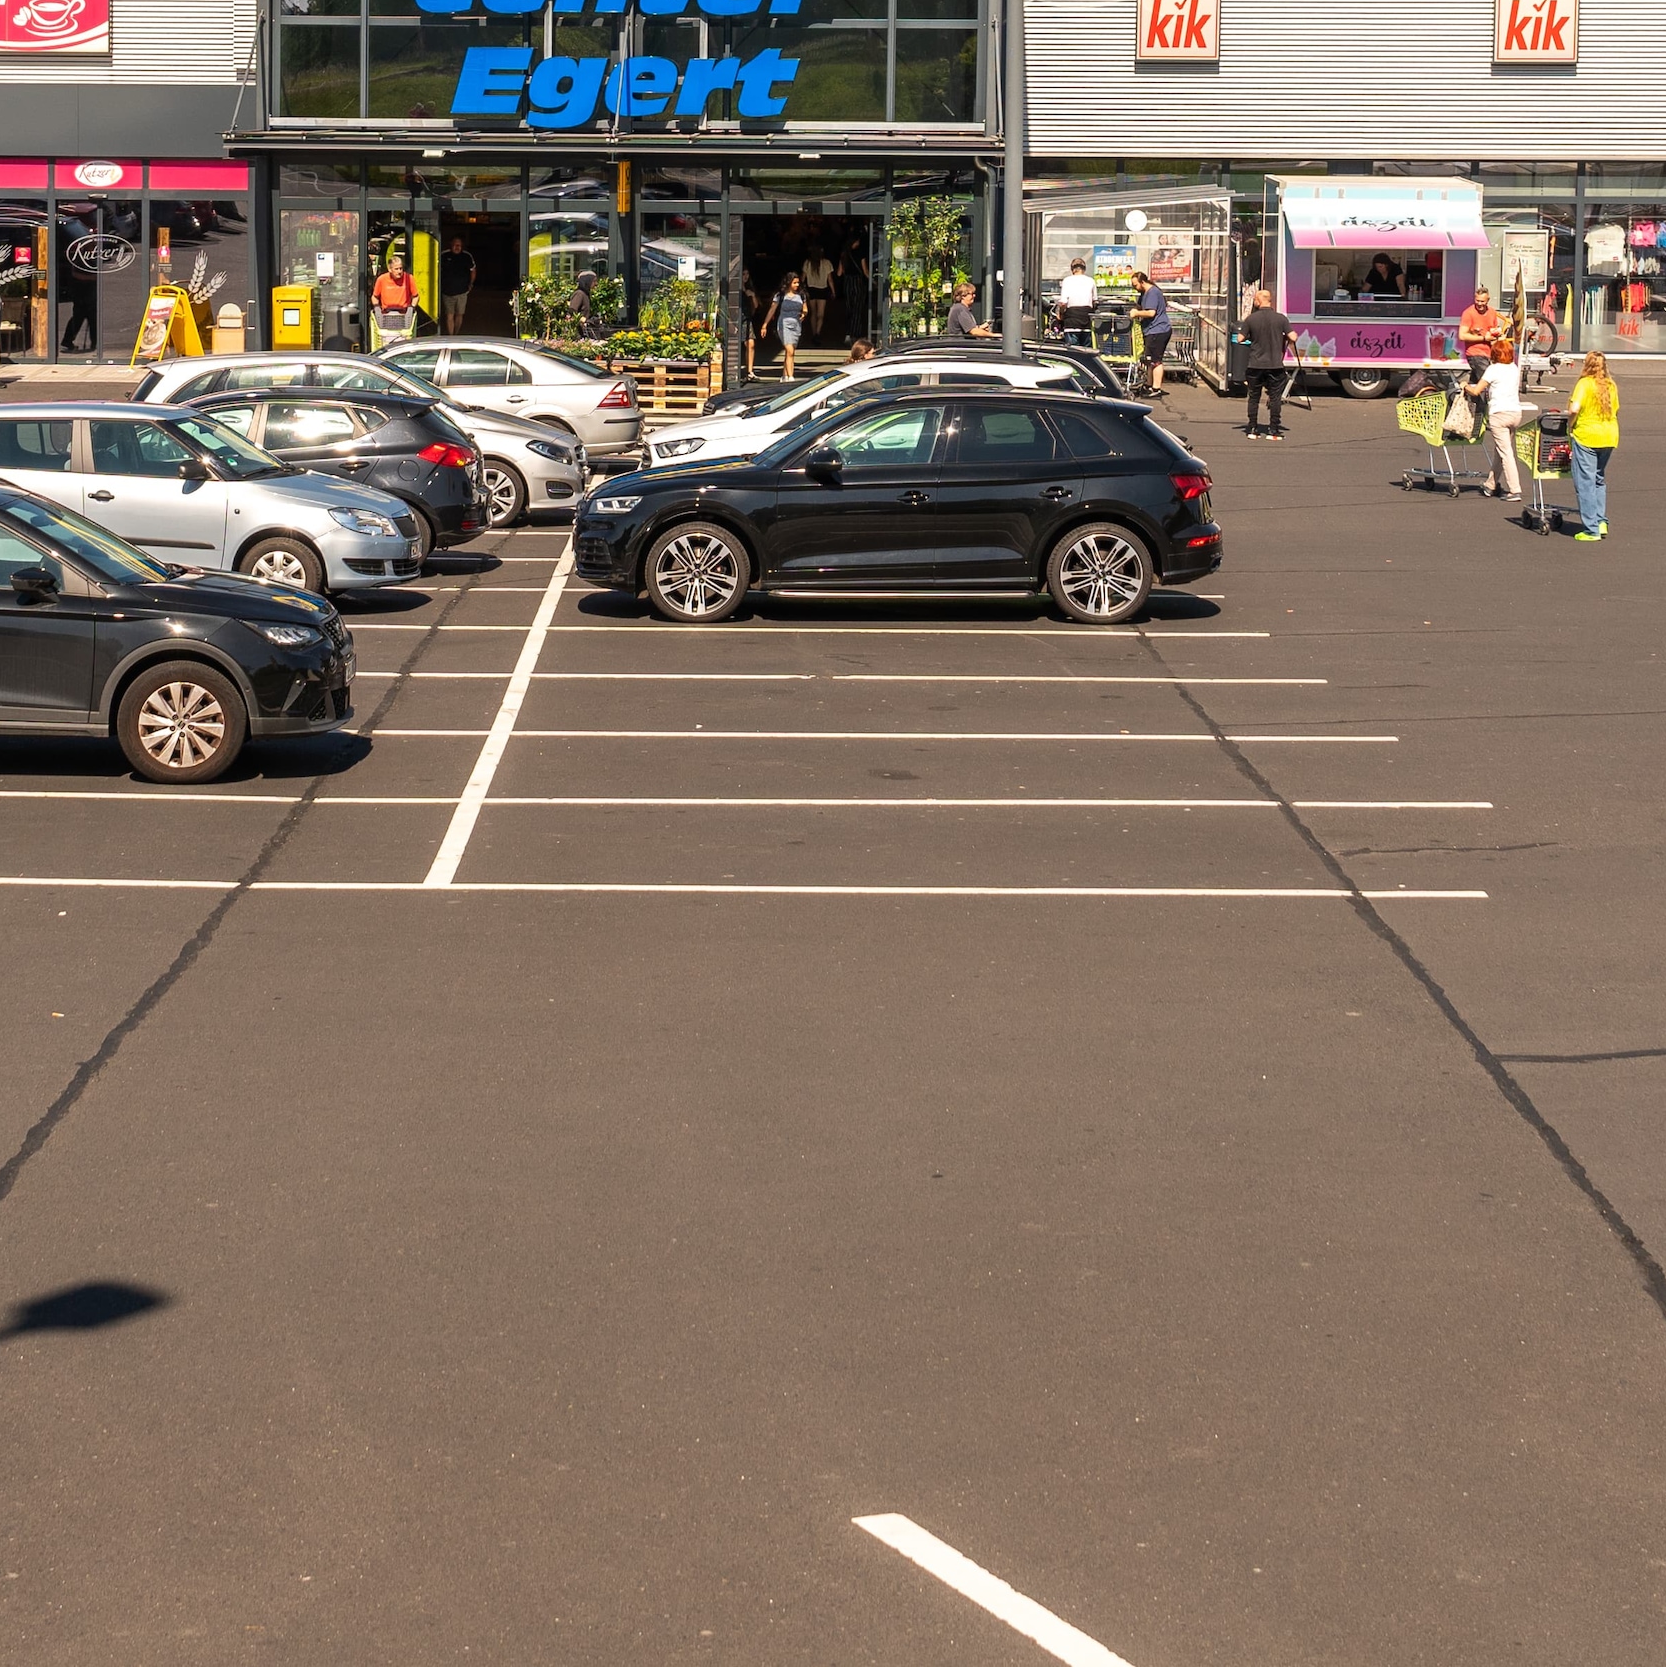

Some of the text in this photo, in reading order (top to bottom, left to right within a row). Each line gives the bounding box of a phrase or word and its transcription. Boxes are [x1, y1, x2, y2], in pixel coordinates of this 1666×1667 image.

[450, 47, 801, 129] Egert
[79, 163, 112, 185] Kutzer
[71, 238, 120, 270] Kutzer
[1618, 317, 1640, 336] kik
